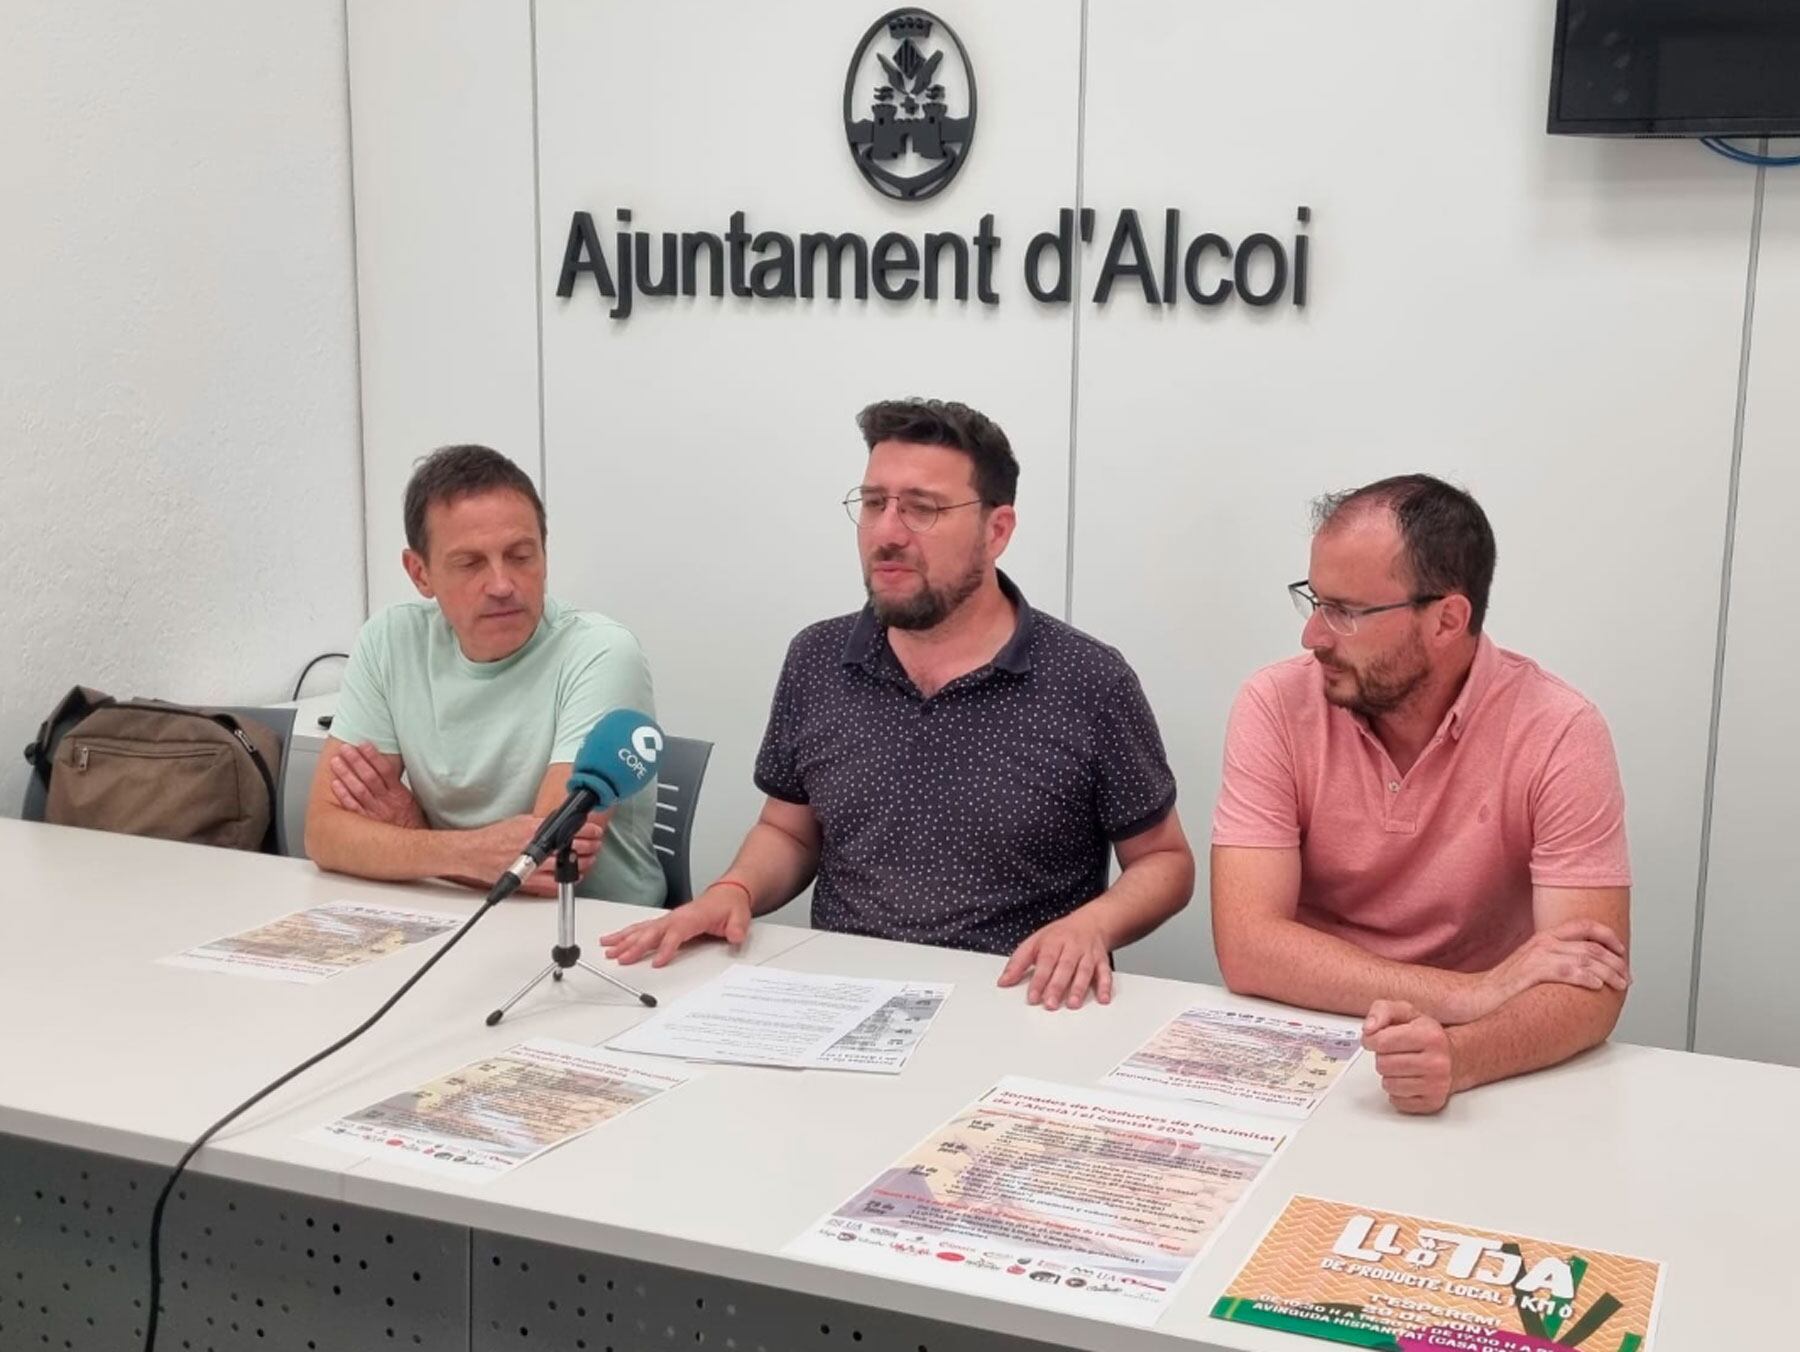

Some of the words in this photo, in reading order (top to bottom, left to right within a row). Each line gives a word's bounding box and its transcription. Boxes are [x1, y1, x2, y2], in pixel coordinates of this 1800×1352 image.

[556, 208, 1001, 318] Ajuntament
[1024, 206, 1310, 307] d'Alcoi
[618, 748, 647, 780] COPE
[990, 1097, 1014, 1105] de
[998, 1090, 1069, 1106] Jornades
[1090, 1106, 1168, 1123] Productes
[1192, 1123, 1276, 1141] Proximitat
[1320, 1258, 1344, 1272] DE
[1347, 1263, 1441, 1291] PRODUCTE
[1444, 1278, 1502, 1304] LOCAL
[1521, 1295, 1556, 1316] KM
[1252, 1302, 1330, 1323] AVINGUDA
[1428, 1334, 1478, 1351] (CASA
[1329, 1307, 1340, 1316] H
[1345, 1310, 1355, 1319] A
[1430, 1327, 1452, 1338] DE
[1399, 1311, 1427, 1325] DE
[1432, 1320, 1498, 1337] JUNY
